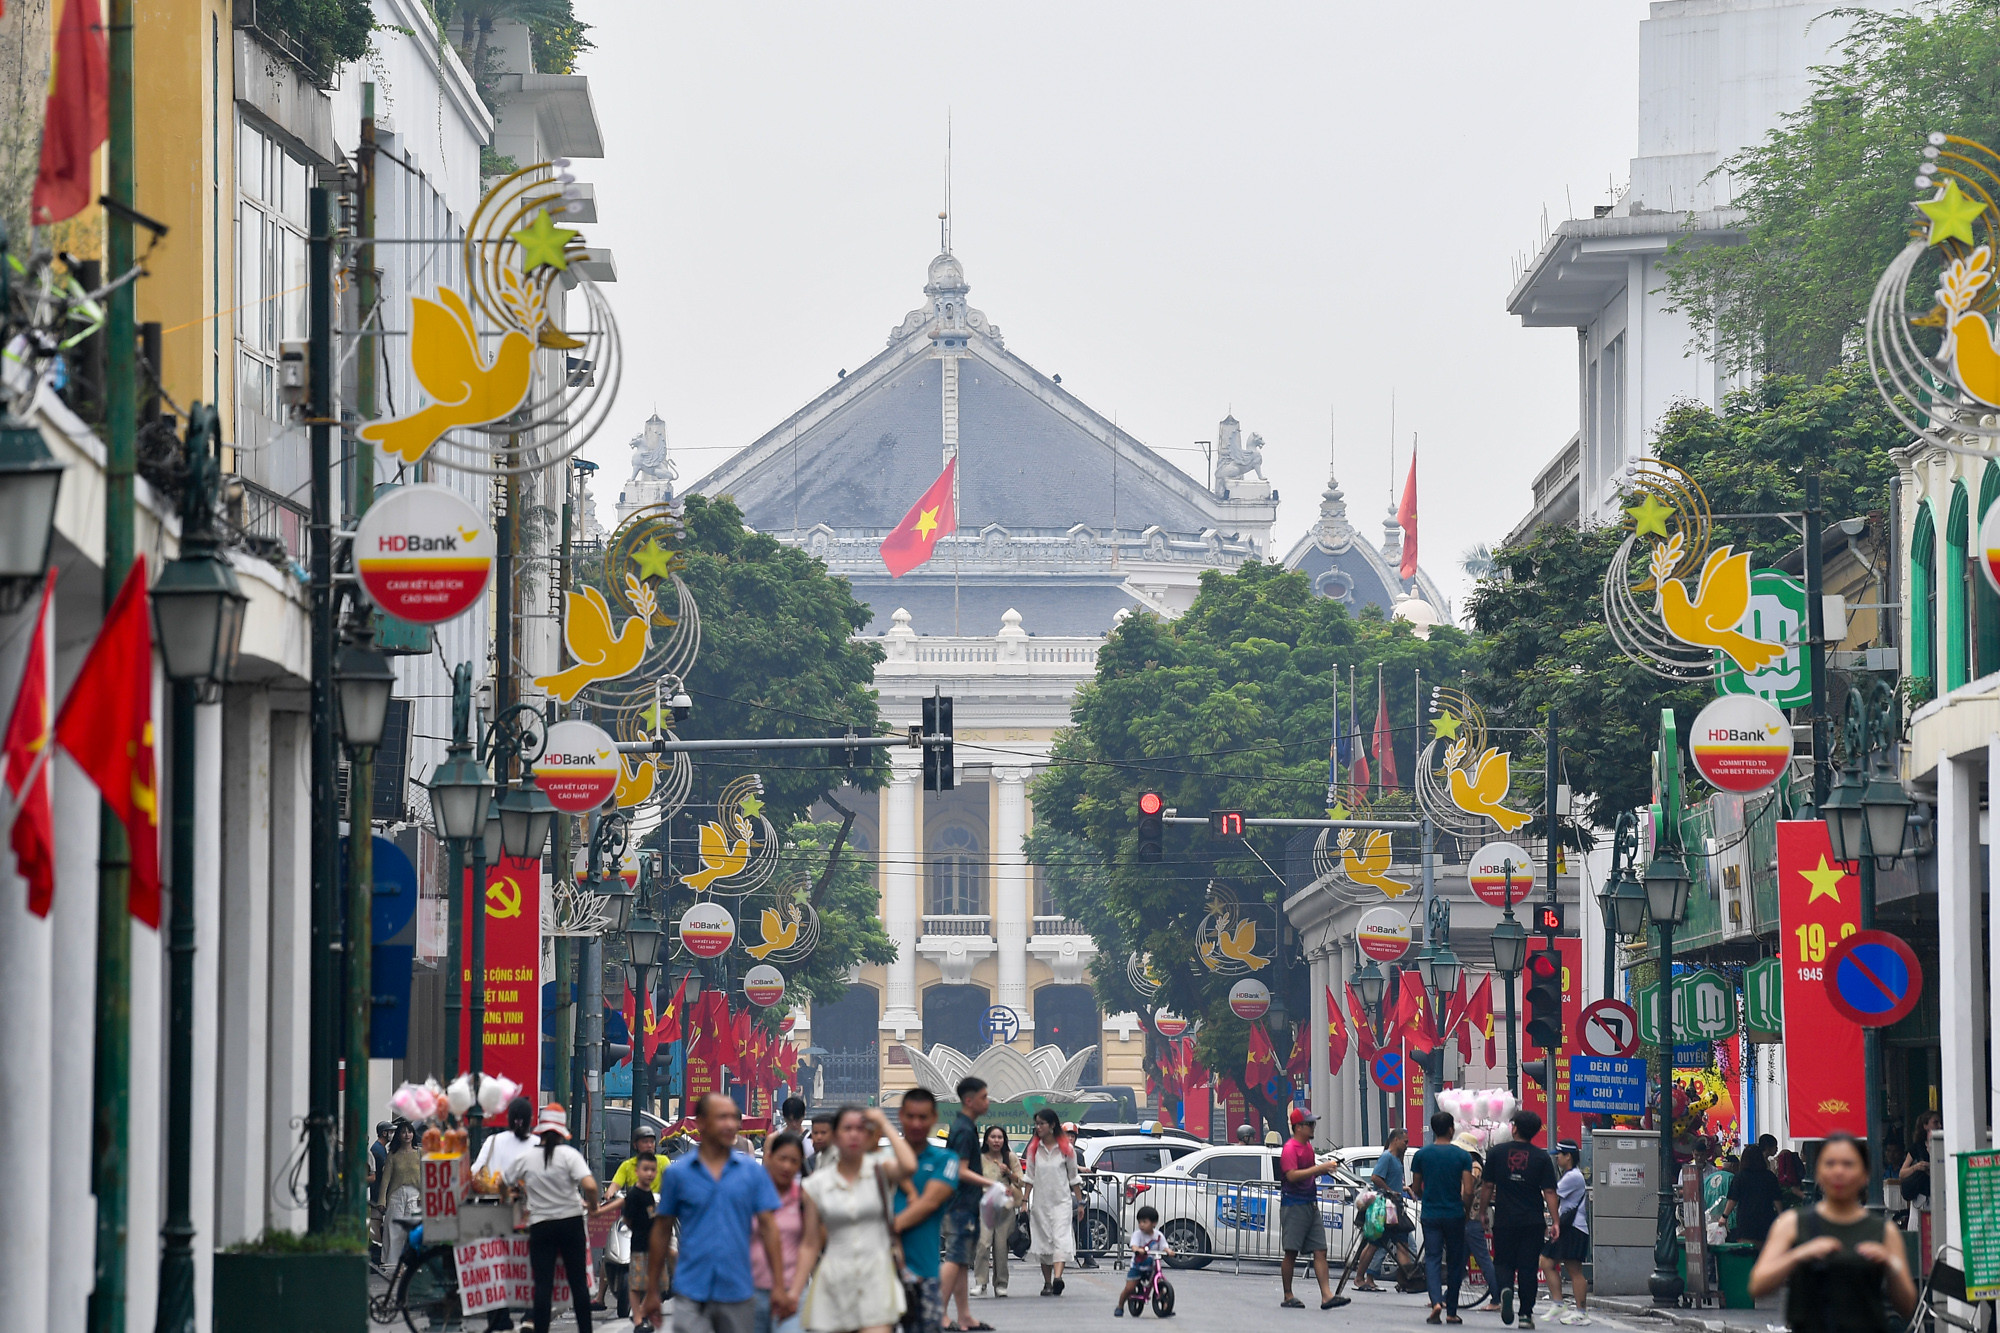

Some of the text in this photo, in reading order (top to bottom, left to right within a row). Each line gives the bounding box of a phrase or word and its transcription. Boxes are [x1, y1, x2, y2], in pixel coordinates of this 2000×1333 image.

[378, 535, 457, 552] HDBank
[386, 580, 409, 590] CAM
[401, 593, 422, 604] CAO
[1708, 729, 1765, 741] HDBank
[544, 753, 596, 765] HDBank
[564, 782, 576, 790] KẾT
[577, 783, 588, 791] LỢI
[588, 782, 599, 790] ÍCH
[1222, 813, 1242, 835] 17
[1479, 865, 1517, 874] HDBak
[1544, 910, 1559, 928] 16
[689, 922, 721, 930] HDBank
[1366, 925, 1398, 934] HDBank
[489, 966, 513, 984] CỘNG
[514, 965, 533, 981] SẢN
[1797, 967, 1823, 981] 1945
[498, 990, 519, 1002] NAM
[503, 1011, 524, 1024] VINH
[499, 1030, 519, 1045] NĂM
[1590, 1059, 1629, 1073] ĐÈN ĐỎ
[1592, 1086, 1624, 1099] CHÚ Ý
[1968, 1155, 1992, 1168] KEM
